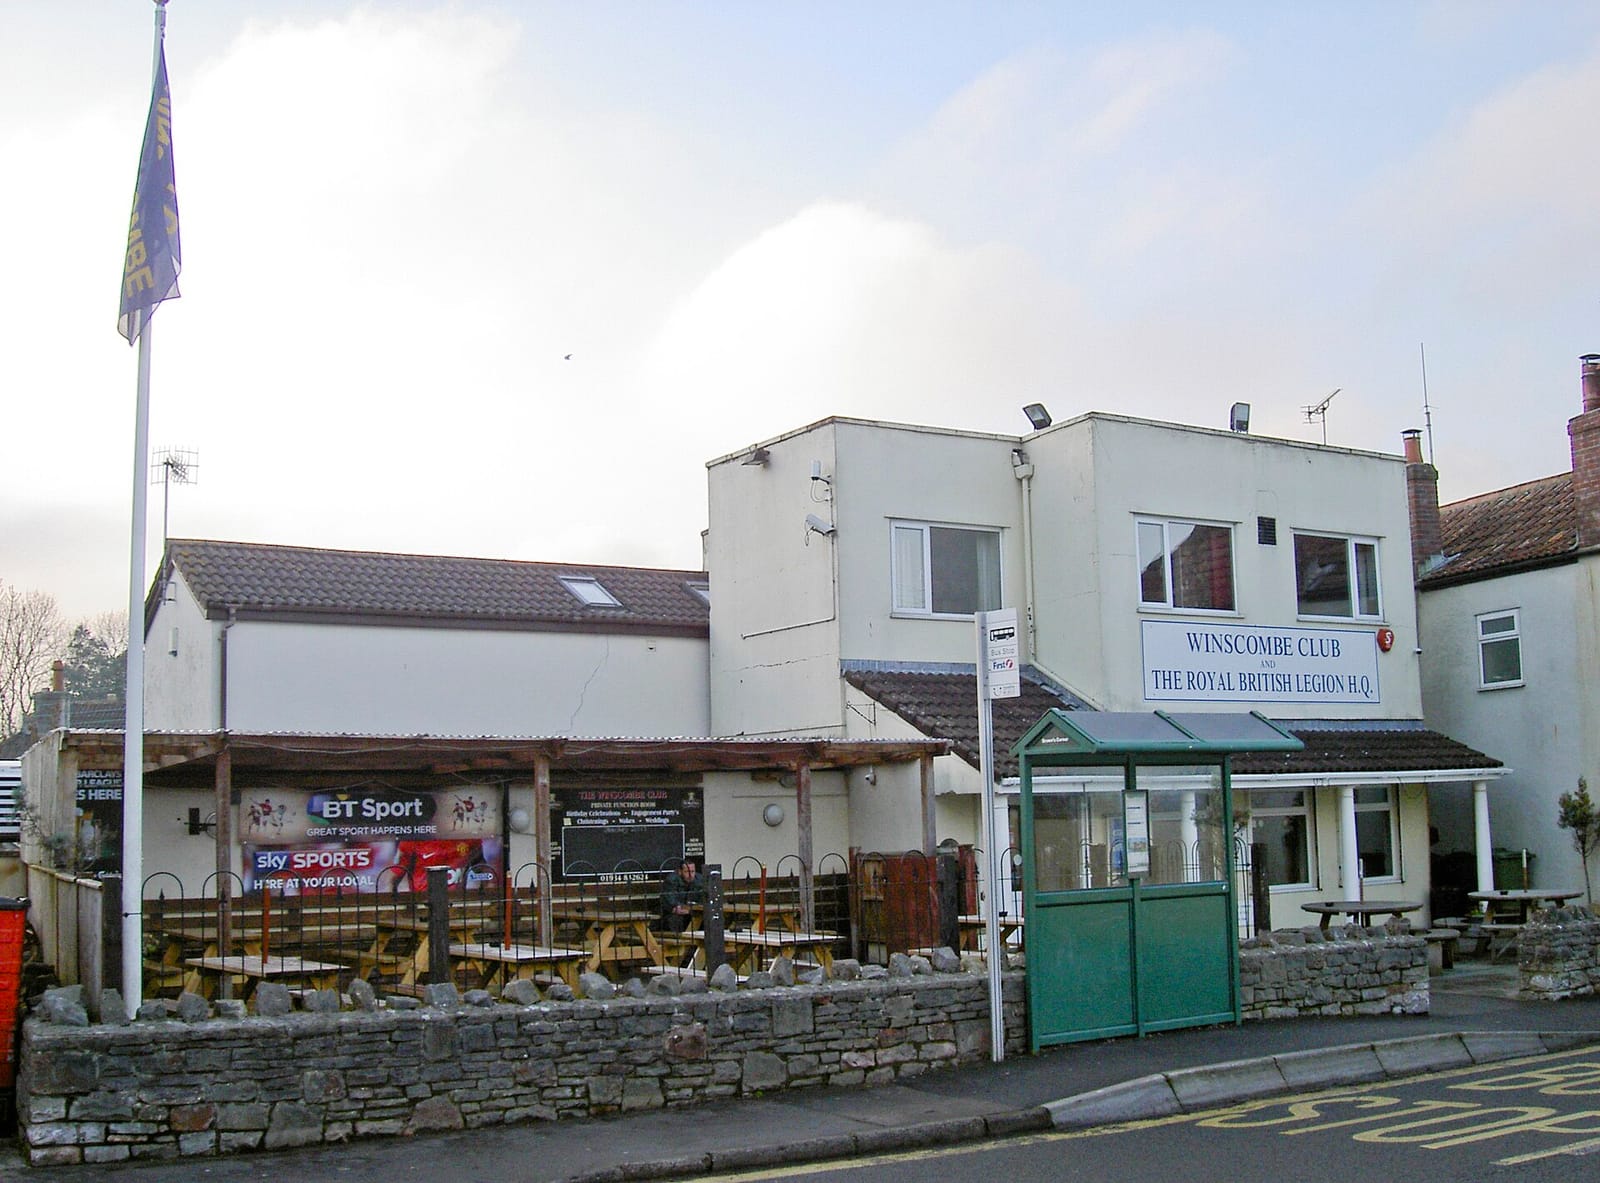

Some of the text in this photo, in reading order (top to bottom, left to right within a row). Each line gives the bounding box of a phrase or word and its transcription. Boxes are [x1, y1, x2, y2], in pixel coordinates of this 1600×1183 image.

[1186, 632, 1341, 658] WINSCOMBE CLUB
[993, 662, 1006, 670] First
[1260, 659, 1276, 669] AND
[1151, 669, 1374, 699] THE ROYAL BRITISH LEGION H.Q.
[88, 788, 122, 800] HERE
[322, 798, 423, 821] BT Sport
[306, 825, 437, 837] GREAT SPORT HAPPENS HERE
[257, 851, 371, 870] sky SPORTS
[286, 878, 300, 889] AT
[302, 877, 336, 888] YOUR
[338, 876, 375, 887] LOCAL
